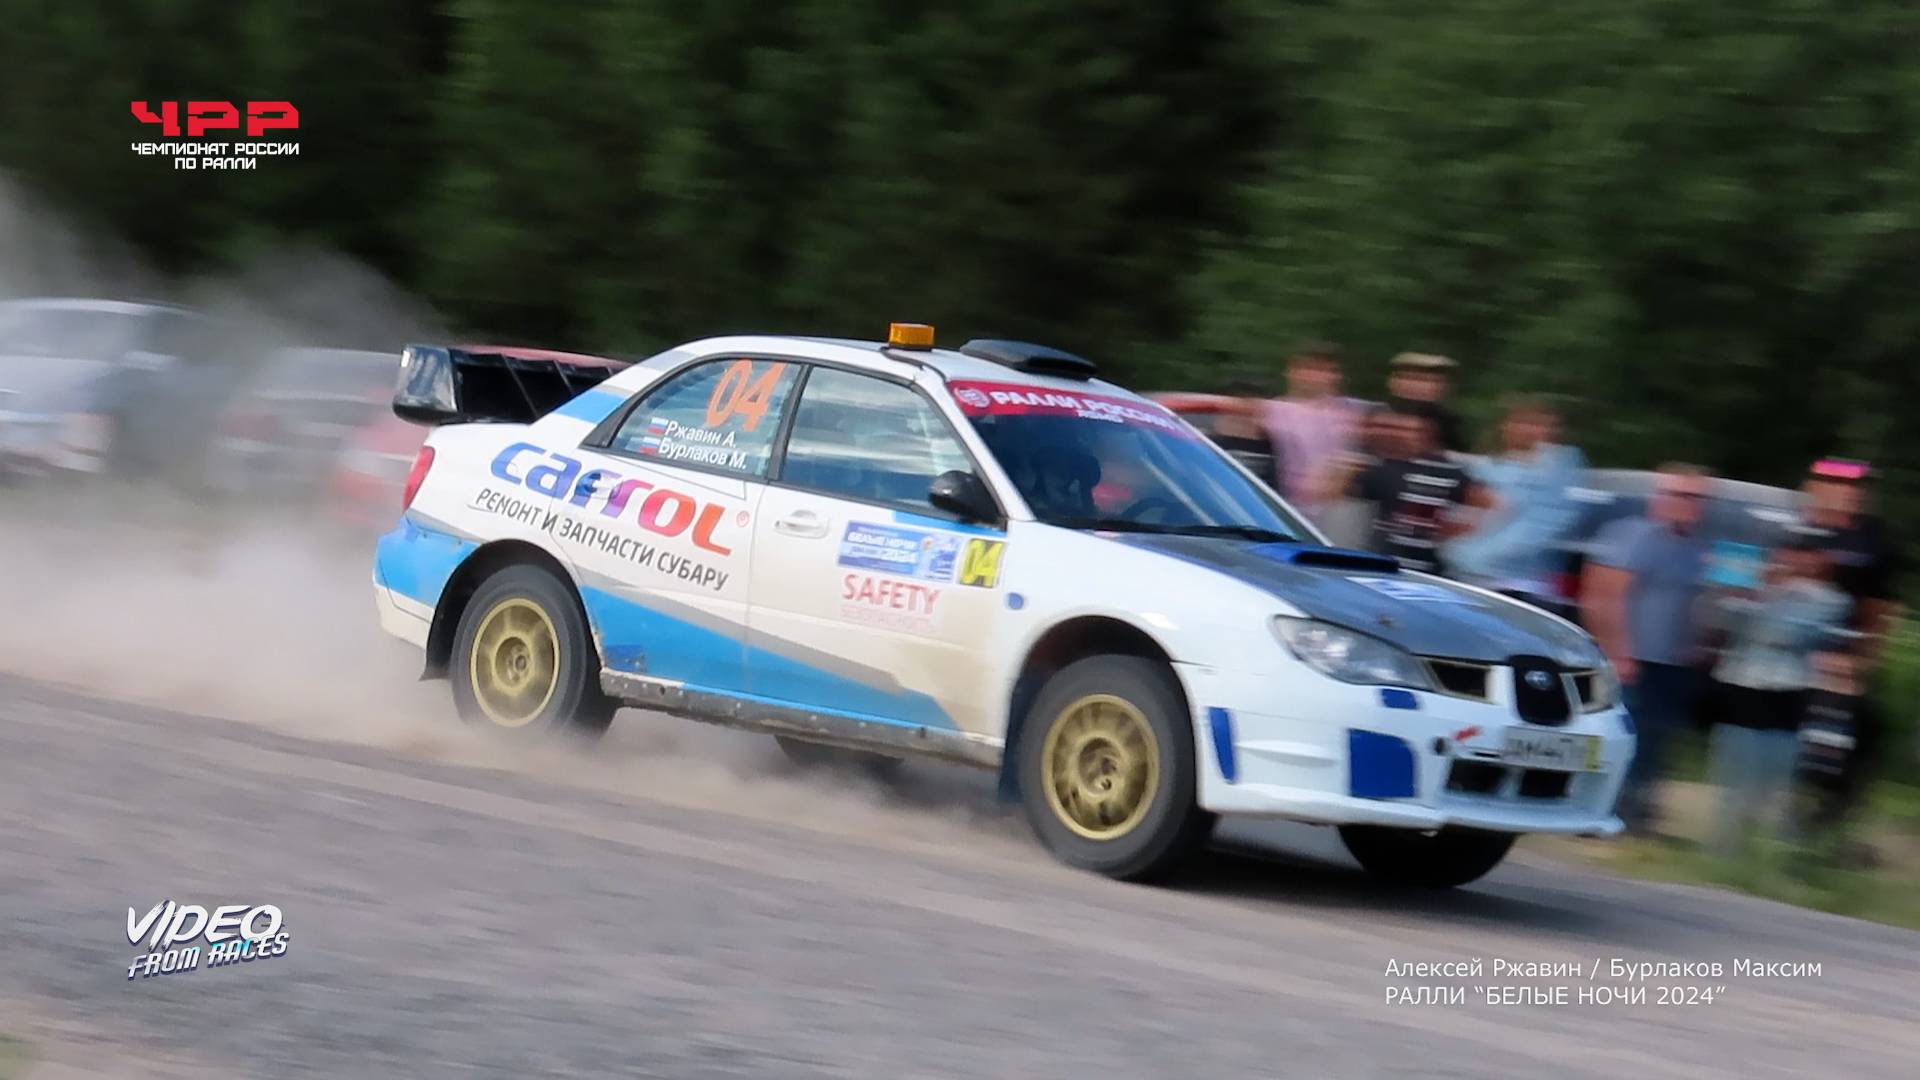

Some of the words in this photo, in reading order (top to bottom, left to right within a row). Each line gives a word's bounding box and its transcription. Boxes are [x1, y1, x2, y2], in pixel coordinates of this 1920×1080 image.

[705, 358, 787, 431] 04
[989, 390, 1079, 410] РАЛЛИ
[658, 437, 728, 465] Бурлаков
[729, 451, 747, 469] М.
[665, 421, 722, 445] Ржавин
[722, 431, 737, 448] А.
[475, 488, 543, 531] РЕМОНТ
[542, 511, 559, 534] И
[559, 517, 656, 567] ЗАПЧАСТИ
[657, 551, 730, 591] СУБАРУ
[842, 573, 943, 615] SAFETY
